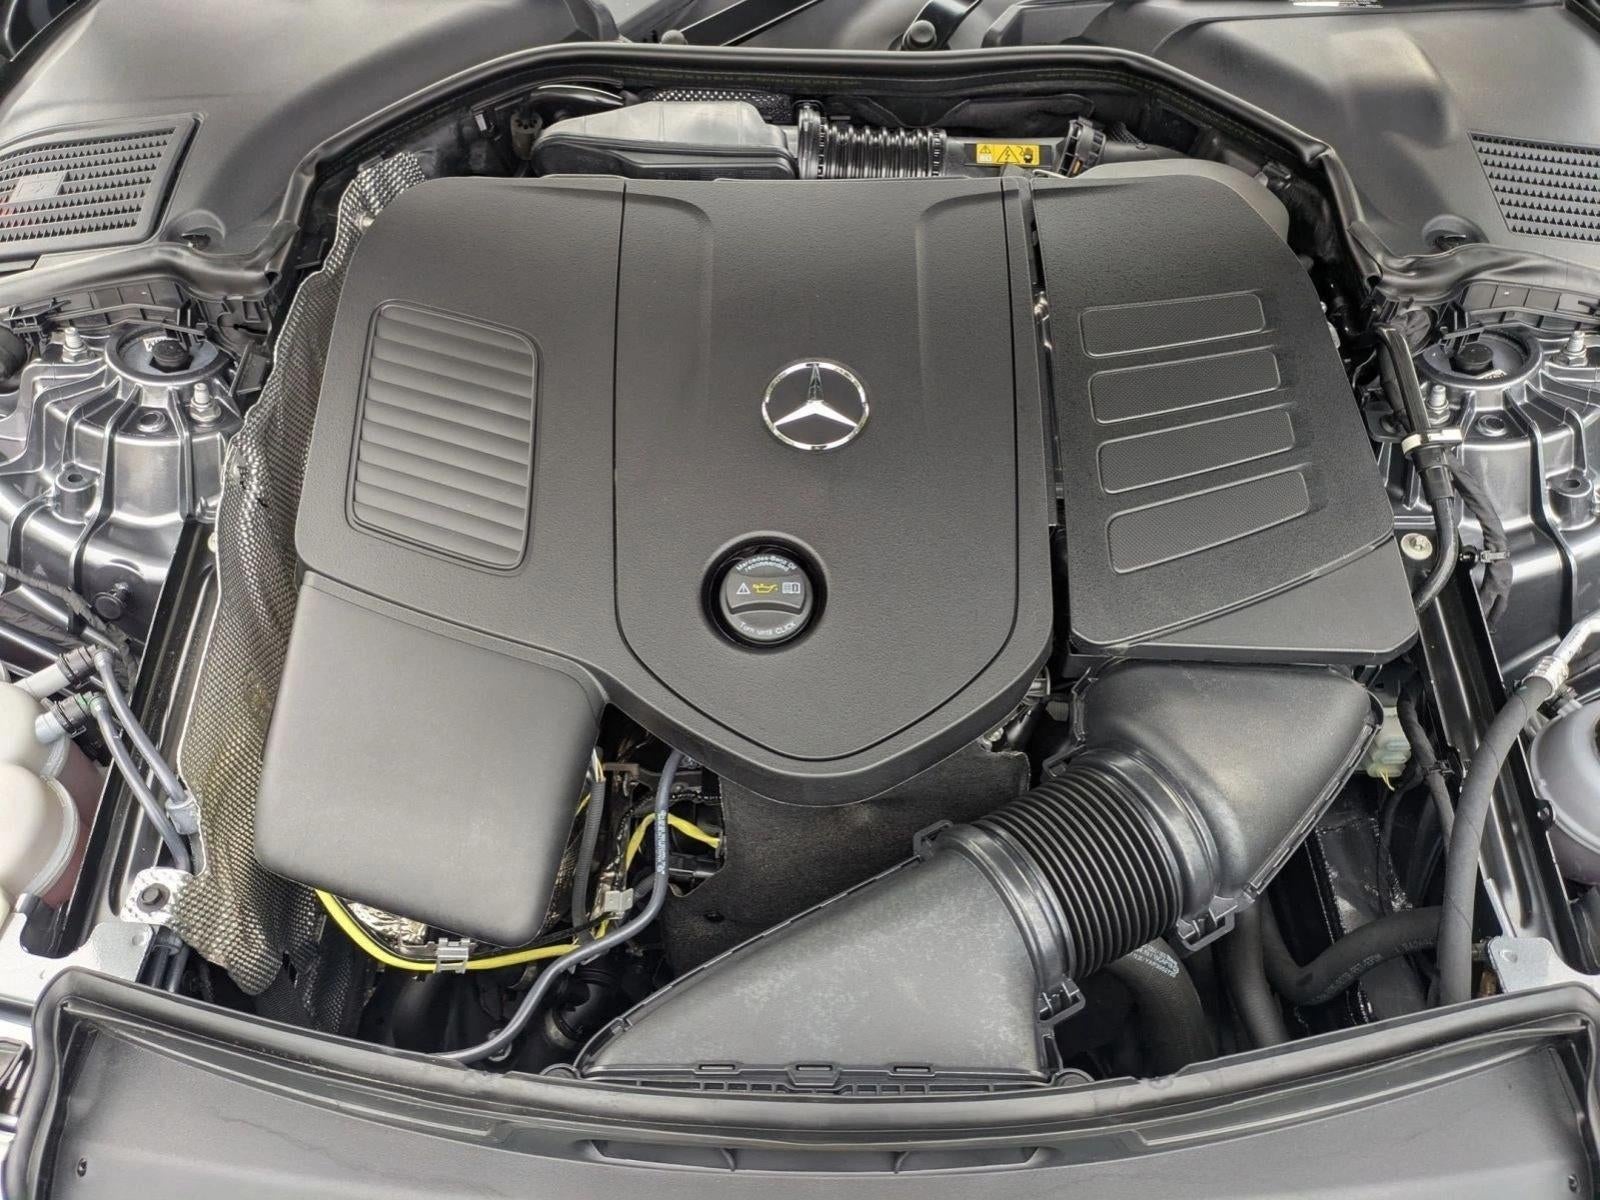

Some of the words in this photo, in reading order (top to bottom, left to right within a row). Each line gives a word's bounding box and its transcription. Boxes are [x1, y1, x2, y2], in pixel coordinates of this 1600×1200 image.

[744, 561, 789, 572] recommended
[740, 621, 755, 633] Turn
[776, 621, 796, 634] CLICK
